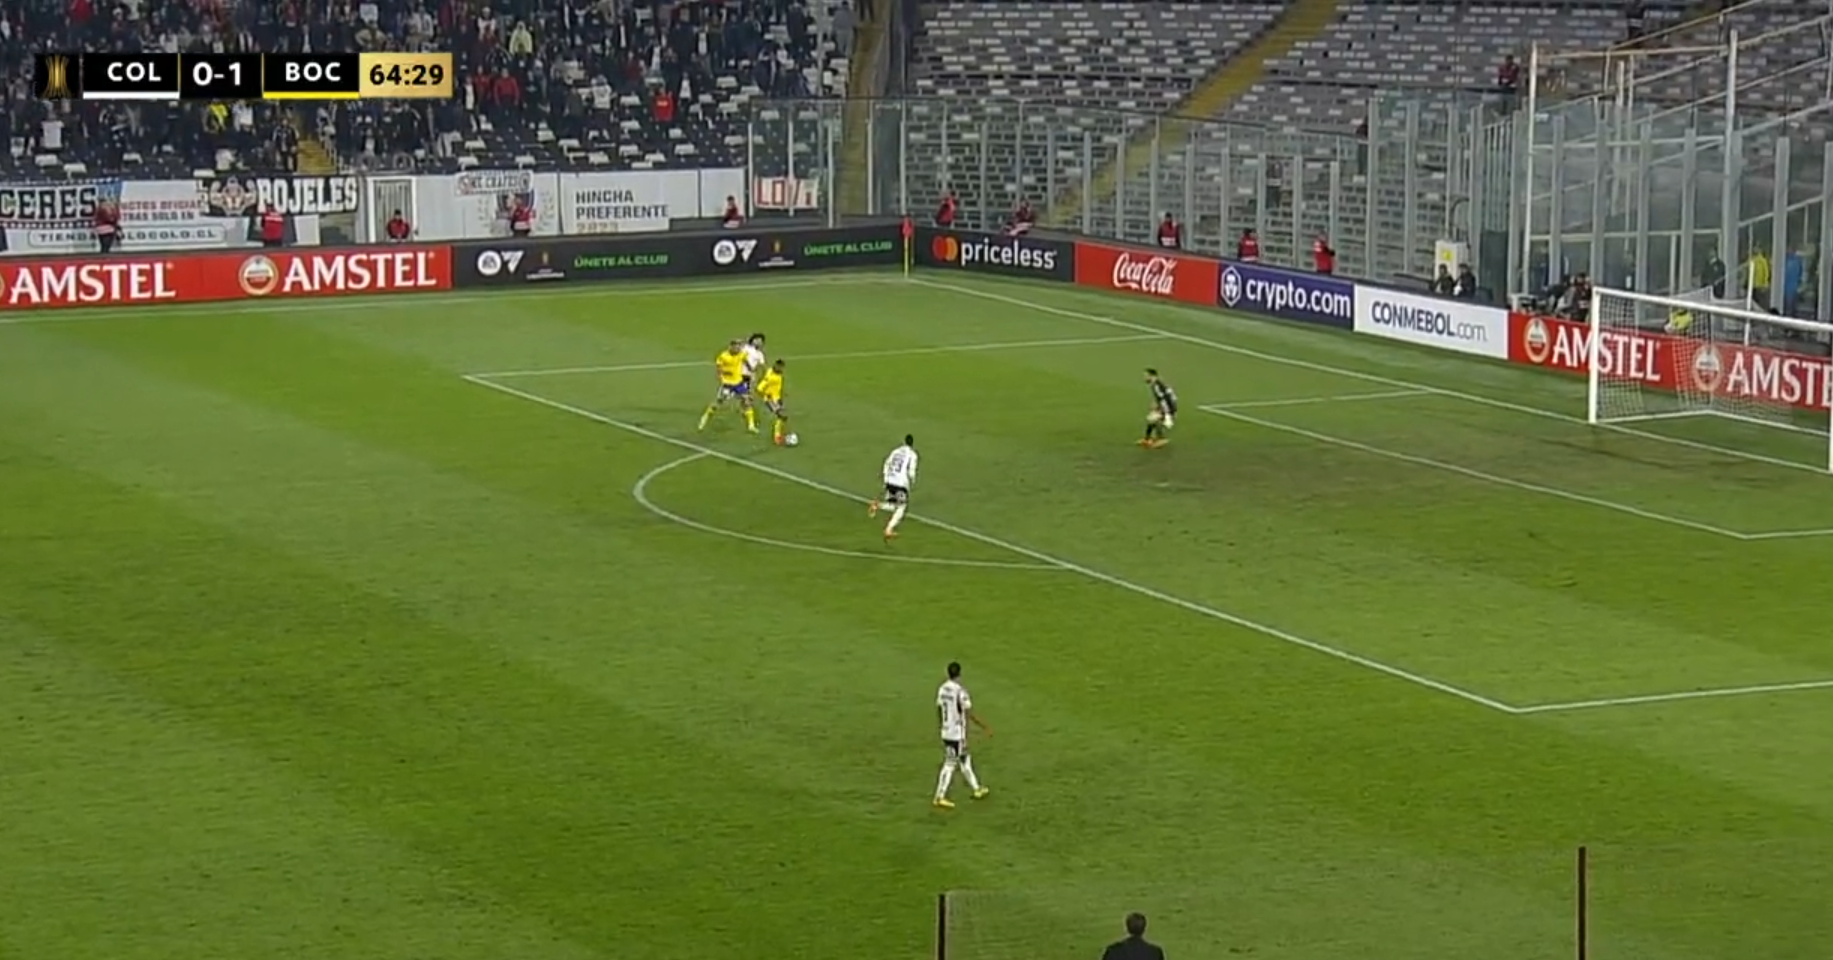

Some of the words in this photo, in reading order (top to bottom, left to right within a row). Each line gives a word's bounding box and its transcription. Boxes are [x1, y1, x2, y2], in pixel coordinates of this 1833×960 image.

[0, 187, 97, 219] CERES
[575, 189, 634, 205] HINCHA
[576, 204, 670, 220] PREFERENTE
[283, 251, 437, 292] AMSTEL
[961, 237, 1055, 270] priceless
[9, 262, 176, 304] AMSTEL
[1246, 279, 1351, 319] crypto.com
[1551, 324, 1661, 382] AMSTEL
[1726, 351, 1833, 407] AMSTE
